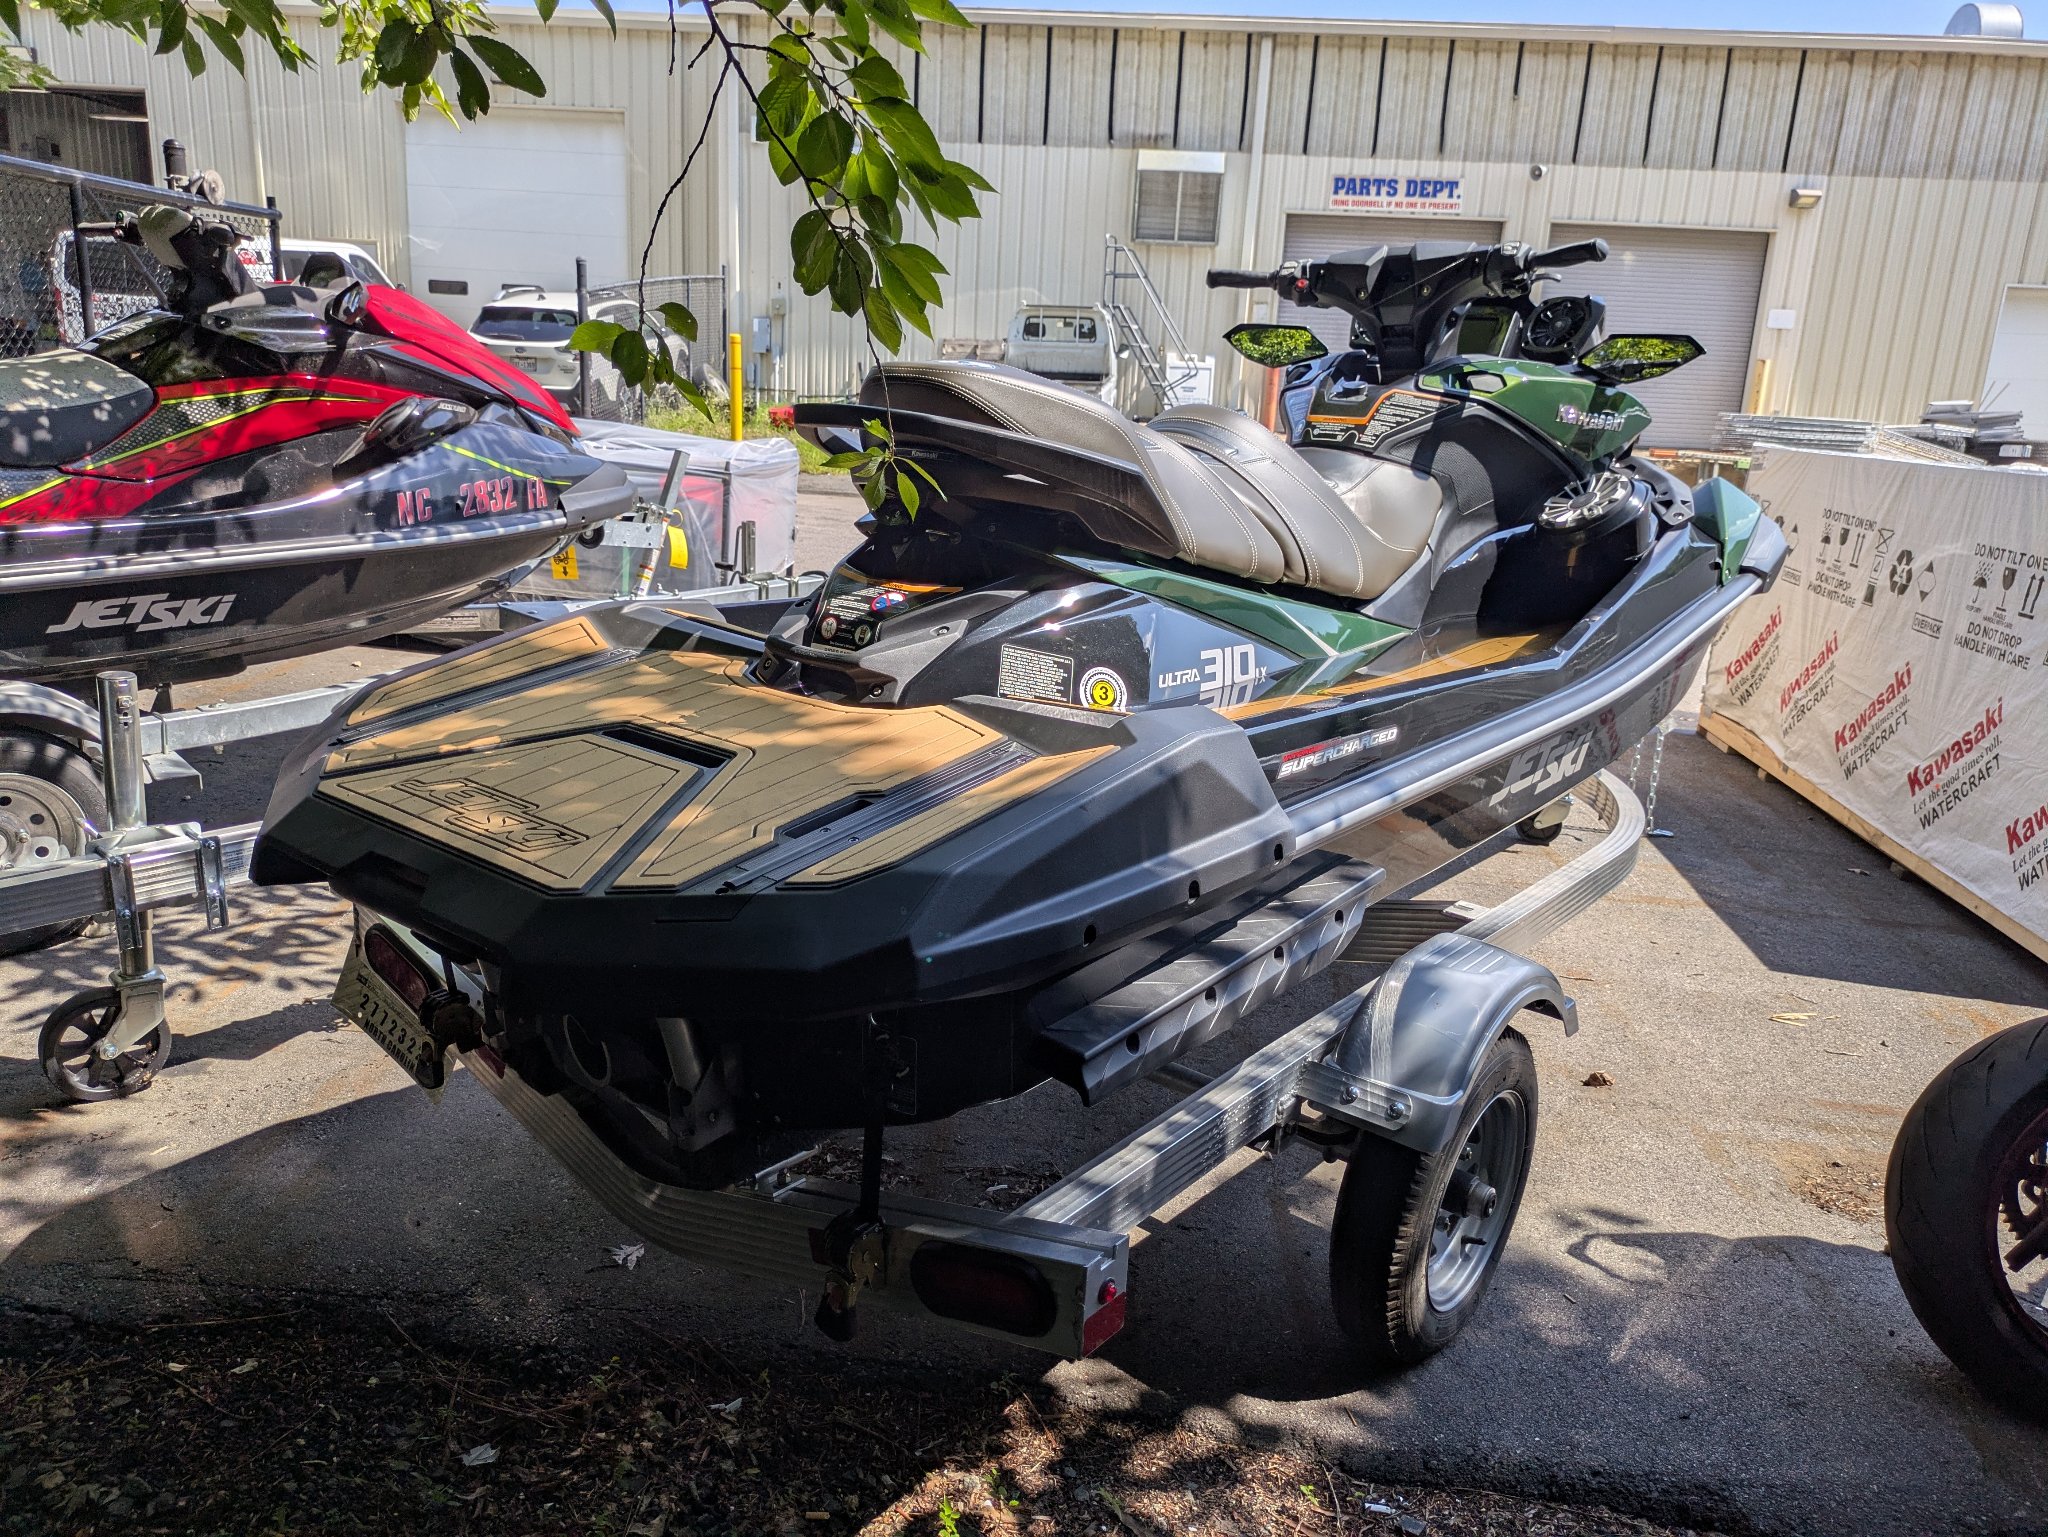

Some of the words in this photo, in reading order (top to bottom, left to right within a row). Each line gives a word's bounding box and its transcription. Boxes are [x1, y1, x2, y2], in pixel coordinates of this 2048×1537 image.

[1332, 177, 1398, 197] PARTS
[1405, 179, 1461, 199] DEPT.
[1351, 199, 1384, 208] DOORBELL
[397, 487, 433, 527] NC
[459, 475, 518, 518] 2832
[526, 476, 548, 510] FA
[1974, 542, 1987, 557] DO
[1986, 545, 2007, 561] NOT
[2006, 549, 2027, 567] TILT
[2026, 554, 2041, 571] ON
[1725, 604, 1783, 685] Kawasaki
[1967, 621, 1981, 637] DO
[1981, 626, 1999, 643] NOT
[1998, 631, 2023, 651] DROP
[1986, 643, 2007, 663] WITH
[2006, 651, 2031, 671] CARE
[1099, 685, 1109, 701] 3
[1158, 667, 1201, 689] ULTRA
[1200, 643, 1256, 692] 310
[1834, 660, 1912, 753] Kawasaki
[1278, 726, 1399, 779] SUPERCHARGED
[1838, 751, 1849, 767] Let
[1875, 709, 1894, 731] times
[1843, 709, 1909, 781] WATERCRAFT
[1906, 696, 2004, 799] Kawasaki
[1913, 798, 1927, 815] Let
[1928, 786, 1942, 804] the
[1941, 768, 1961, 796] good
[1961, 751, 1985, 776] times
[1984, 734, 2003, 757] roll.
[1918, 752, 2001, 831] WATERCRAFT
[2012, 853, 2027, 874] Let
[2028, 843, 2042, 861] the
[359, 993, 421, 1060] 277232
[363, 1018, 388, 1047] NORTH
[386, 1040, 417, 1075] CAROLIN
